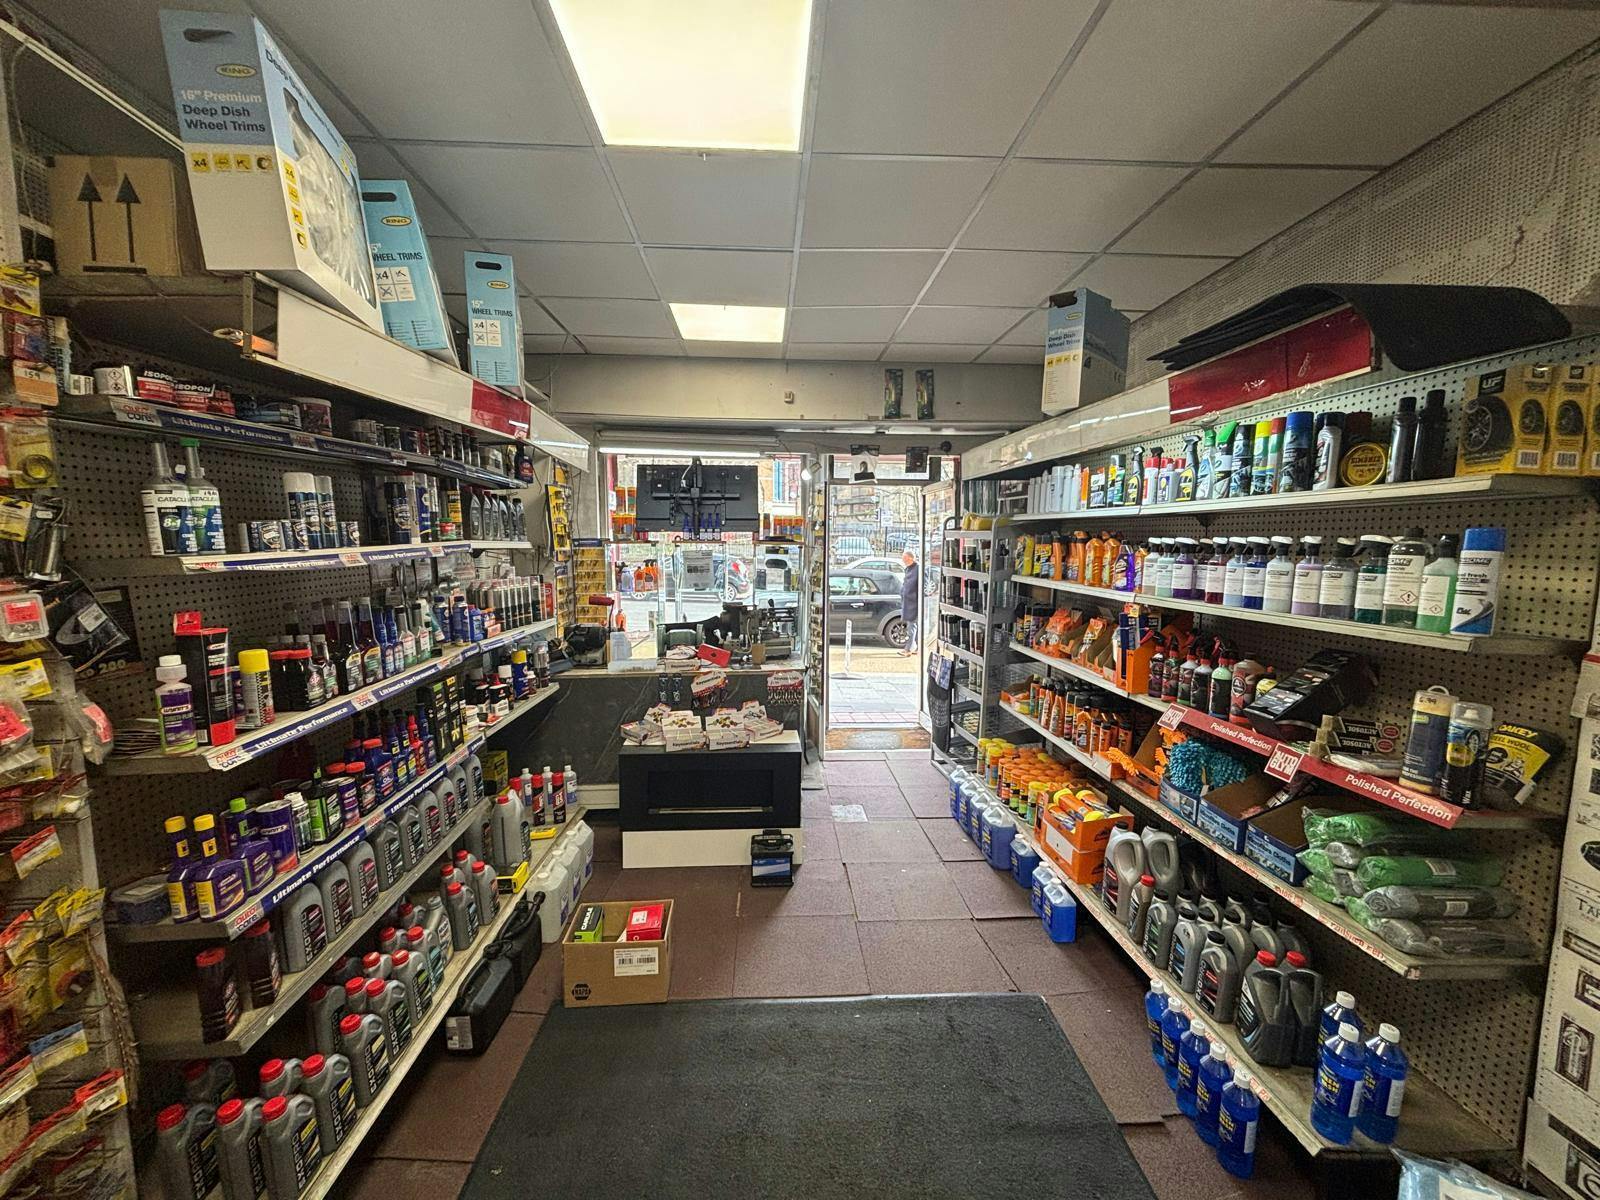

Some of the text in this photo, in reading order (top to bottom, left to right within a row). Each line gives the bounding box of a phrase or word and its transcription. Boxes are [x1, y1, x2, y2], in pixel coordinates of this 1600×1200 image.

[220, 67, 252, 75] RING
[204, 91, 263, 103] Premium
[182, 104, 250, 117] Deep Dish
[185, 119, 266, 132] Wheel Trims
[193, 158, 207, 167] x4
[397, 252, 423, 261] TRIMS
[376, 270, 389, 280] x4
[472, 308, 513, 318] WHEEL TRIMS
[474, 321, 484, 329] x4
[172, 416, 283, 442] Ultimate Performance
[369, 549, 427, 560] Ultimate Performance
[379, 666, 436, 696] Ultimate Performance
[256, 706, 349, 749] Ultimate Performance
[1498, 724, 1538, 738] OAKEY
[1210, 722, 1273, 752] Polished Perfection
[1507, 738, 1530, 751] WOOL
[1275, 750, 1299, 767] AUTO
[1269, 759, 1294, 776] GLYM
[390, 769, 445, 815] Ultimate Performance
[1345, 773, 1453, 822] Polished Perfection
[272, 870, 312, 904] Ultimate
[312, 834, 361, 874] Performance
[235, 906, 257, 923] auto
[1576, 896, 1600, 918] TA
[238, 913, 259, 932] care
